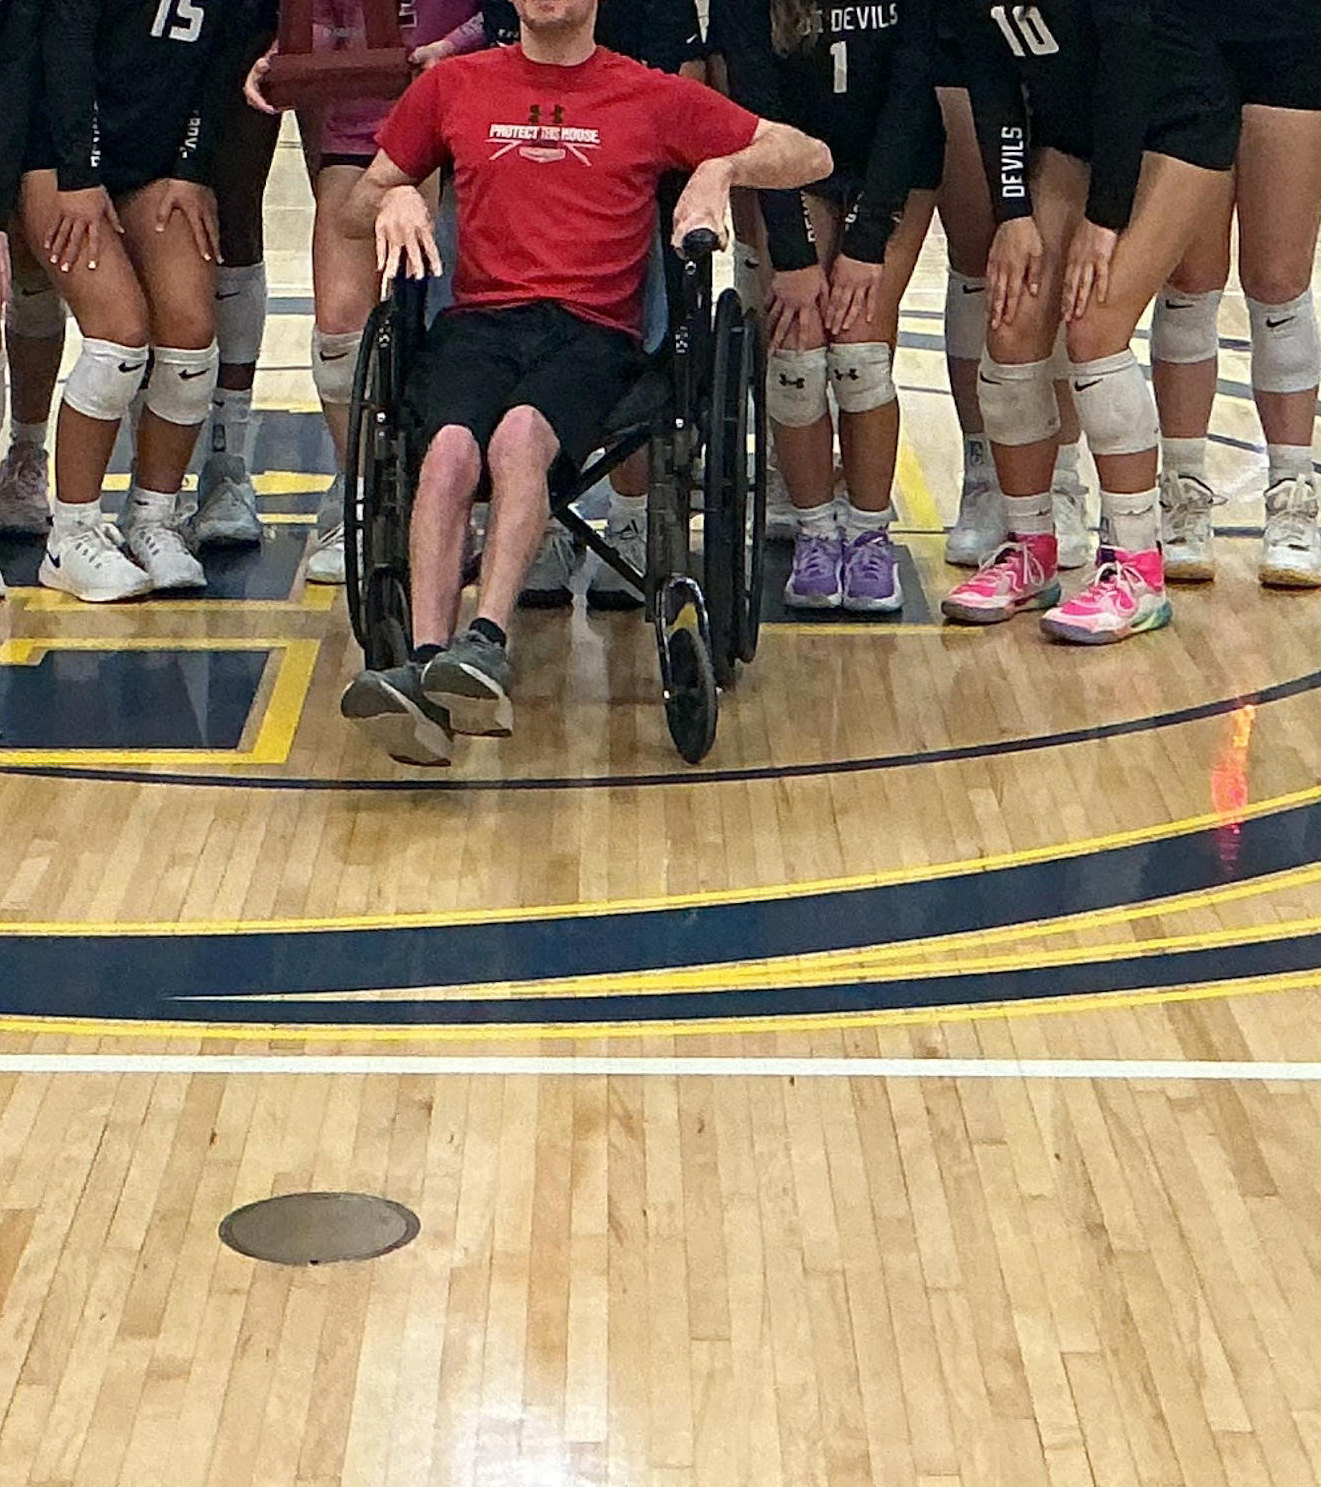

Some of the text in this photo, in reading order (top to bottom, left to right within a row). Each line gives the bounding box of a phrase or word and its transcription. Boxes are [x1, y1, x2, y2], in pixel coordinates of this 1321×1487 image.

[831, 2, 899, 32] DEVILS
[991, 5, 1060, 57] 10
[830, 40, 847, 93] 1
[489, 123, 538, 140] PROTECT
[1000, 126, 1026, 199] DEVILS
